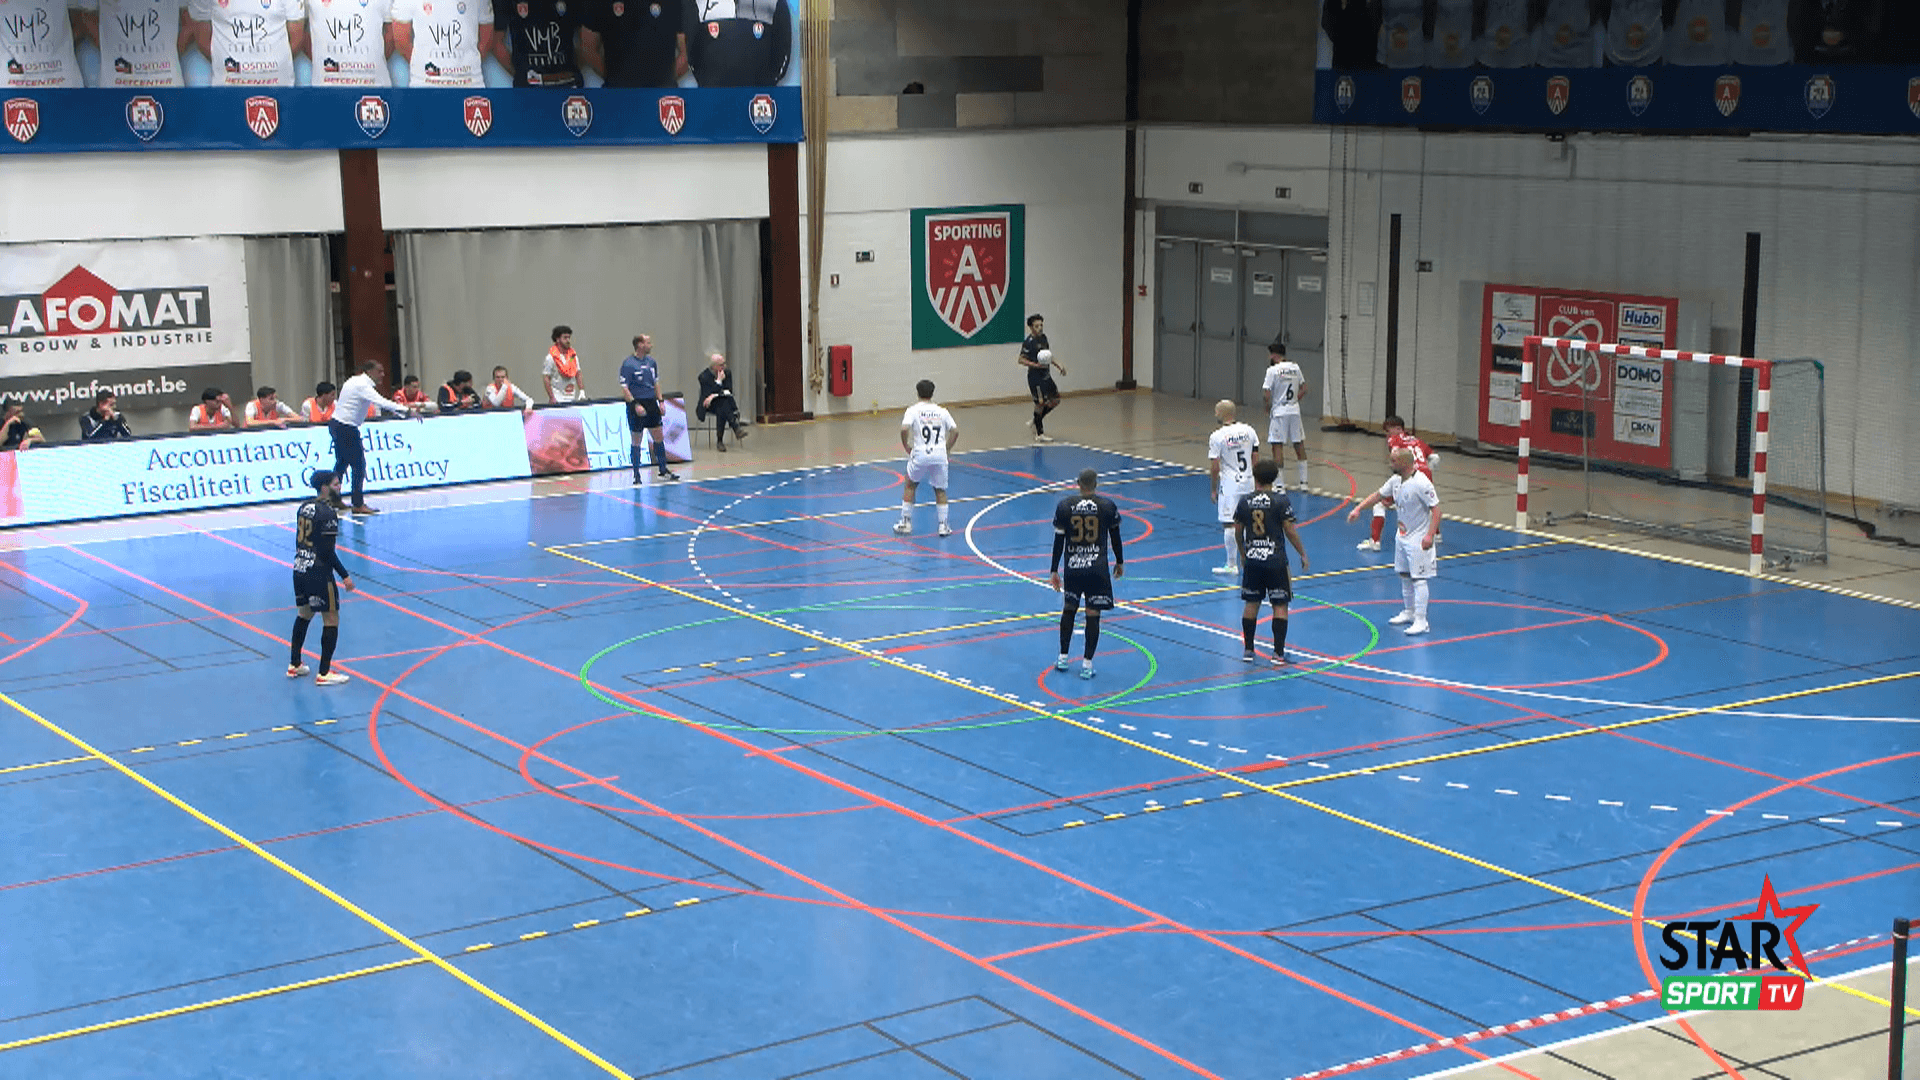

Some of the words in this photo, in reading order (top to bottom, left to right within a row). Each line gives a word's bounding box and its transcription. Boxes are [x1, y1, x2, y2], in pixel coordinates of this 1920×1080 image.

[934, 223, 1001, 241] SPORTING
[954, 243, 982, 283] A
[0, 291, 203, 334] AFOMAT
[1558, 304, 1578, 315] CLUB
[1625, 309, 1659, 325] Hubo
[20, 340, 78, 353] BOUW
[91, 337, 101, 349] &
[114, 332, 212, 348] INDUSTRIE
[1618, 365, 1661, 383] DOMO
[1286, 383, 1294, 401] 6
[922, 425, 941, 445] 97
[1631, 421, 1655, 433] DKN
[147, 441, 320, 471] Accountancy,
[1236, 451, 1247, 472] 5
[122, 473, 252, 505] Fiscaliteit
[262, 473, 293, 493] en
[1070, 515, 1099, 543] 39
[1252, 509, 1265, 536] 8
